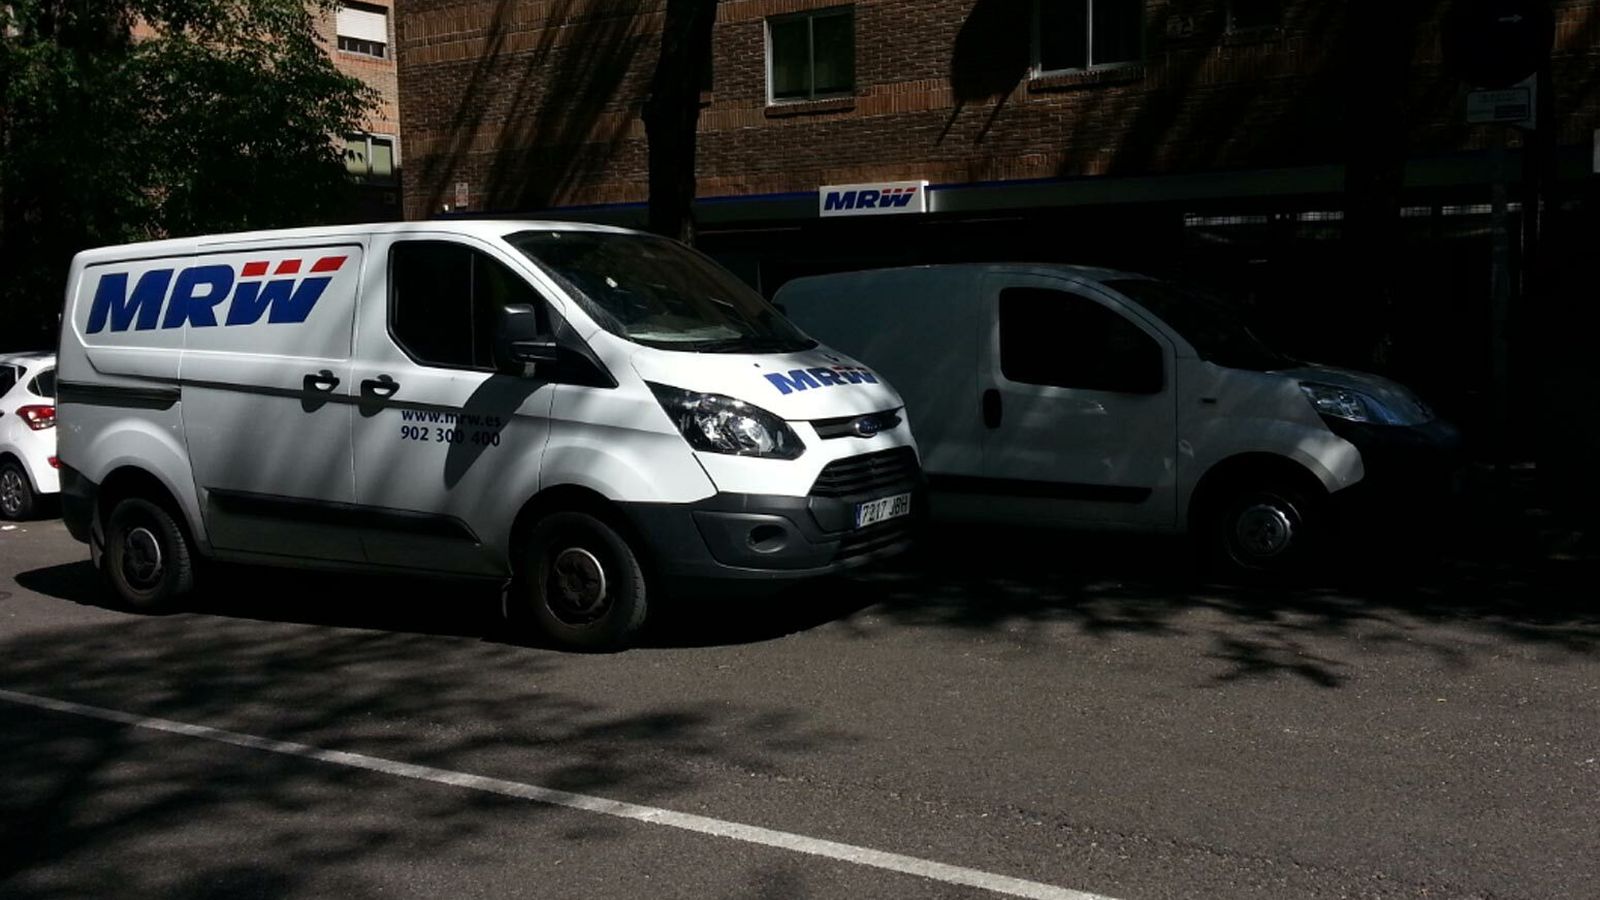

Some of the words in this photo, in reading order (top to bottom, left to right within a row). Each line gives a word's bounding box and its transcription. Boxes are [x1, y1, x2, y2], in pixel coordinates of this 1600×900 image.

[824, 187, 917, 211] MRW
[86, 256, 347, 334] MRW
[764, 366, 880, 395] MRW
[402, 410, 501, 428] www.mrw.es
[401, 425, 429, 441] 902
[436, 428, 464, 444] 300
[471, 430, 500, 447] 400
